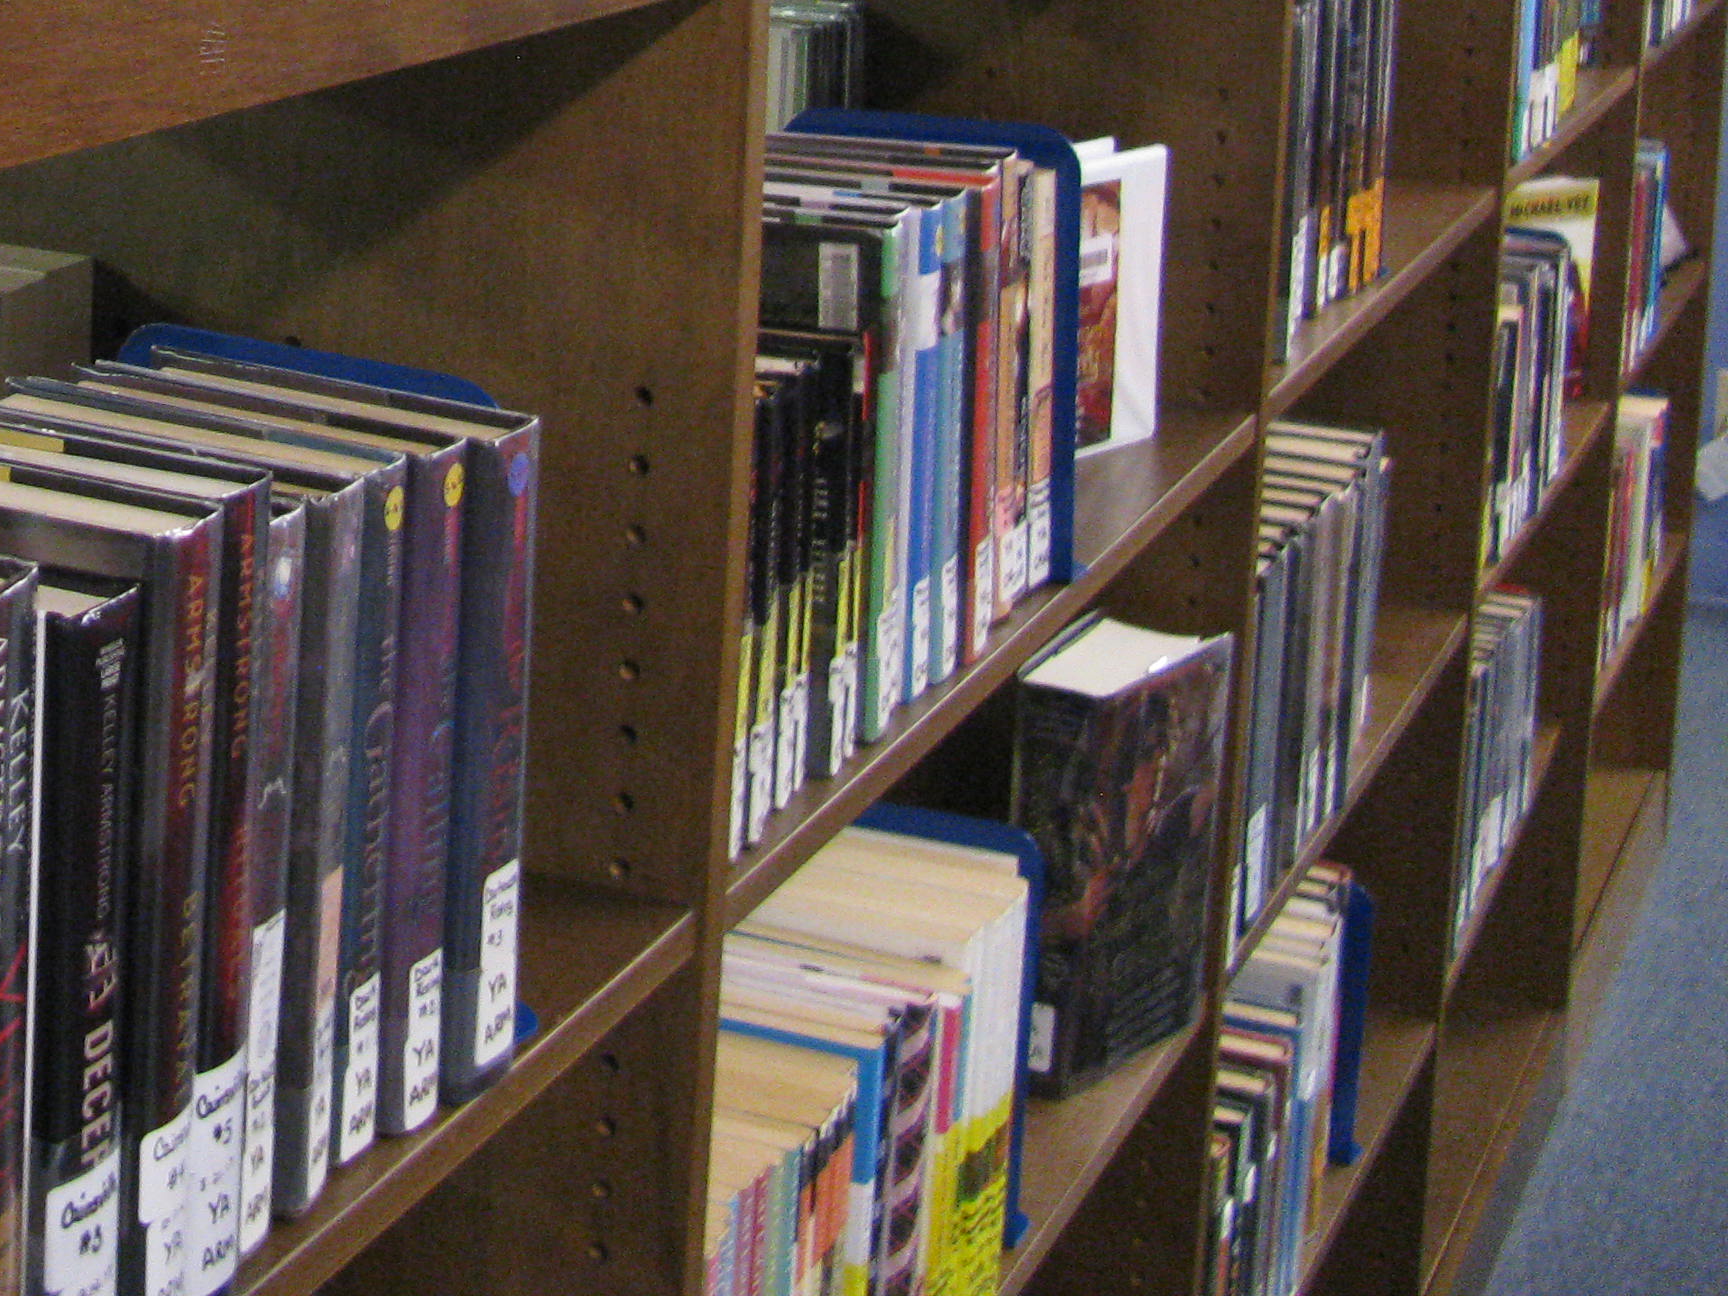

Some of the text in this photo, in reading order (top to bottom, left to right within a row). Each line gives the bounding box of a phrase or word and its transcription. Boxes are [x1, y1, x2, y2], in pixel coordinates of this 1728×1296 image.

[230, 532, 257, 758] ARMSTRONG
[177, 574, 203, 806] ARMSTRONG
[7, 688, 30, 854] KELLEY
[487, 971, 508, 1005] YA
[413, 1037, 436, 1069] YA
[355, 1067, 373, 1097] YA
[208, 1192, 231, 1225] YA
